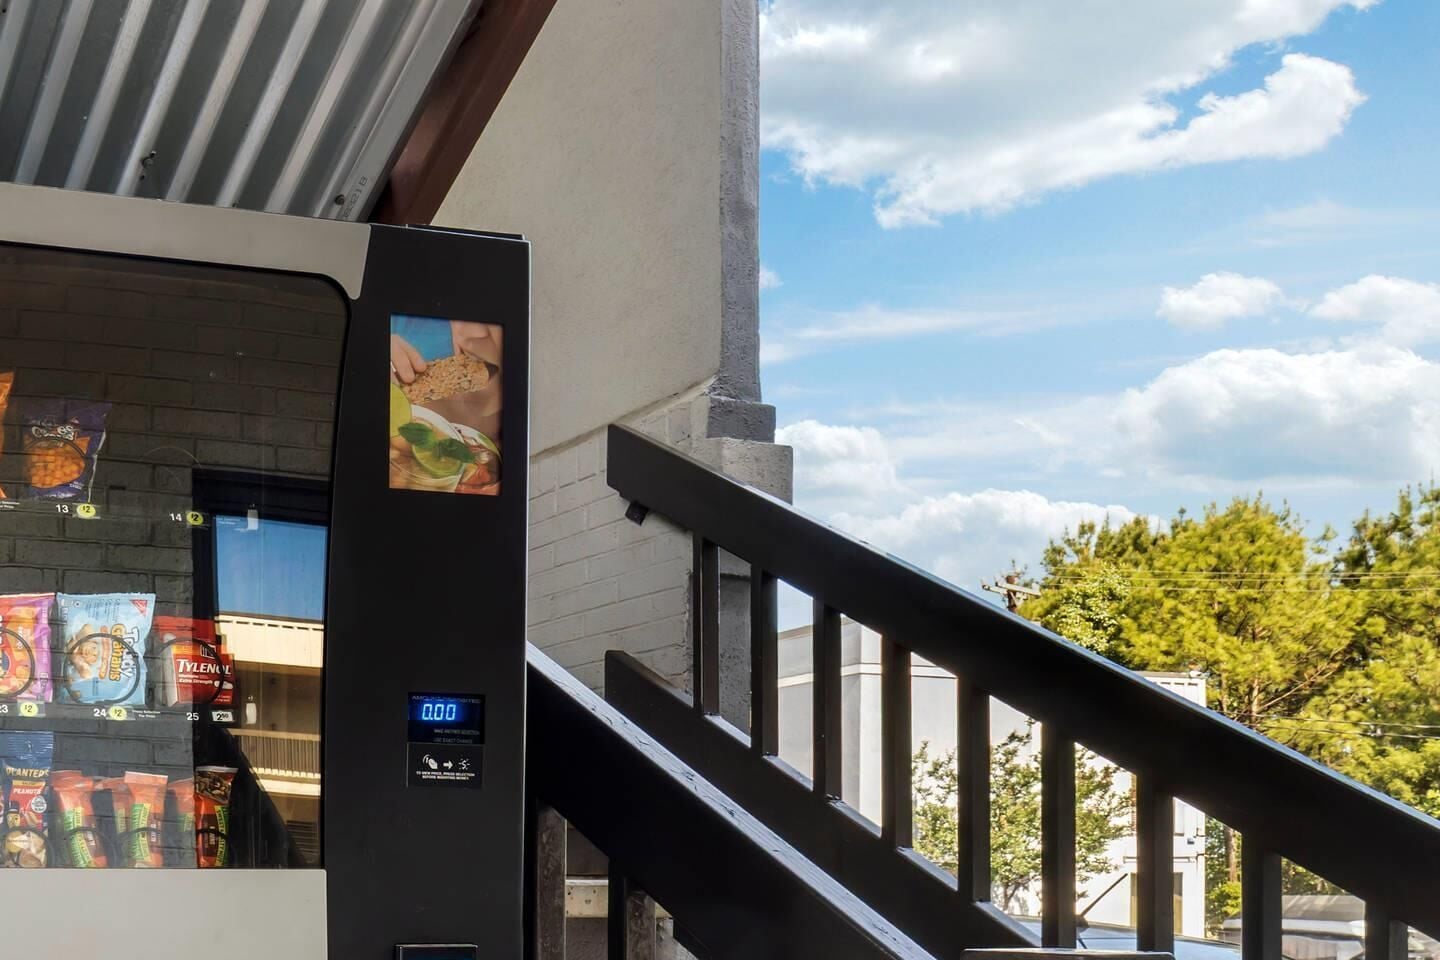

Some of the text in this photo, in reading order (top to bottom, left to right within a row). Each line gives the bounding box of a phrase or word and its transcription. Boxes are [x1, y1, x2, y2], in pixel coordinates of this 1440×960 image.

[56, 504, 69, 513] 13
[83, 505, 91, 513] $2
[170, 513, 182, 522] 14
[109, 623, 127, 681] Gahams
[175, 659, 232, 675] TYLENOL
[24, 704, 33, 713] $2
[114, 709, 122, 717] $2
[93, 709, 107, 718] 24
[186, 712, 200, 721] 25
